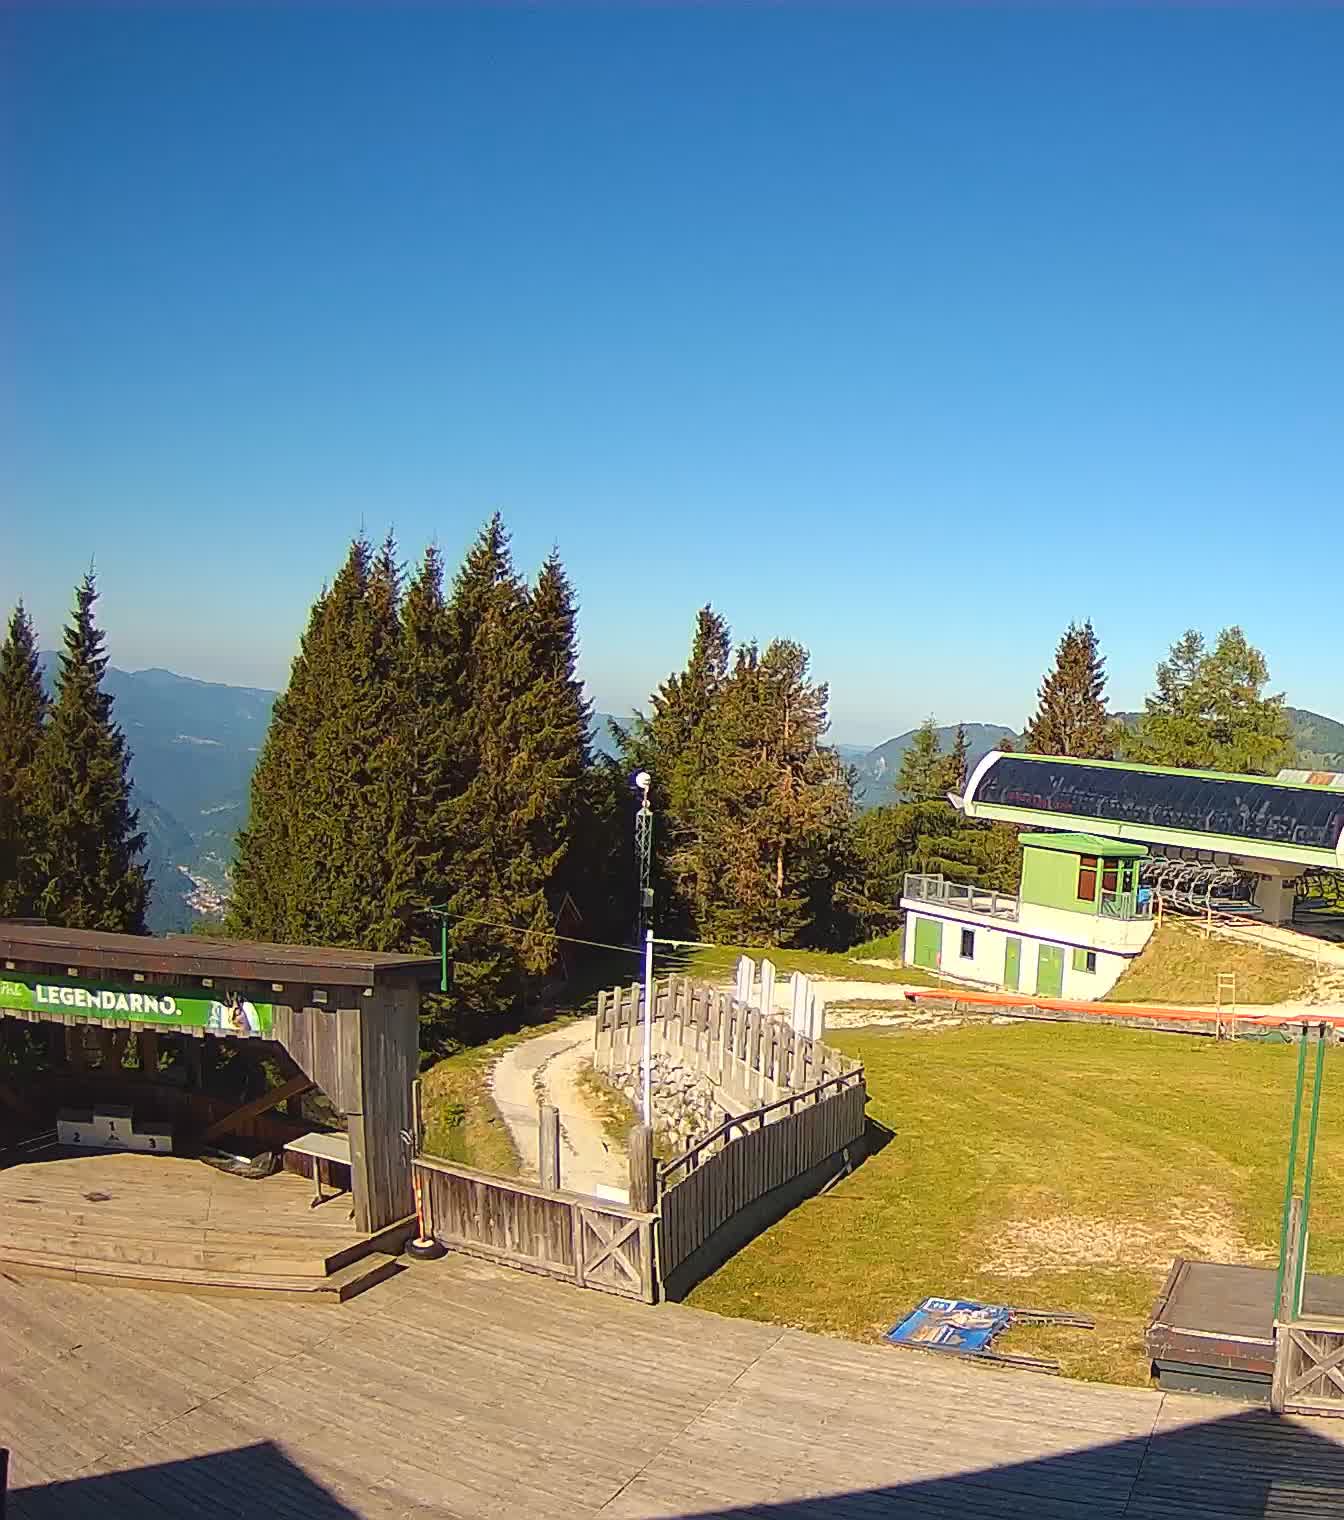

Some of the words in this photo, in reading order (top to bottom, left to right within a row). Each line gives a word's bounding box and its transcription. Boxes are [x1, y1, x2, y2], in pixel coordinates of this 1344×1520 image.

[108, 1120, 116, 1132] 1
[72, 1132, 81, 1143] 2
[148, 1137, 156, 1149] 3
